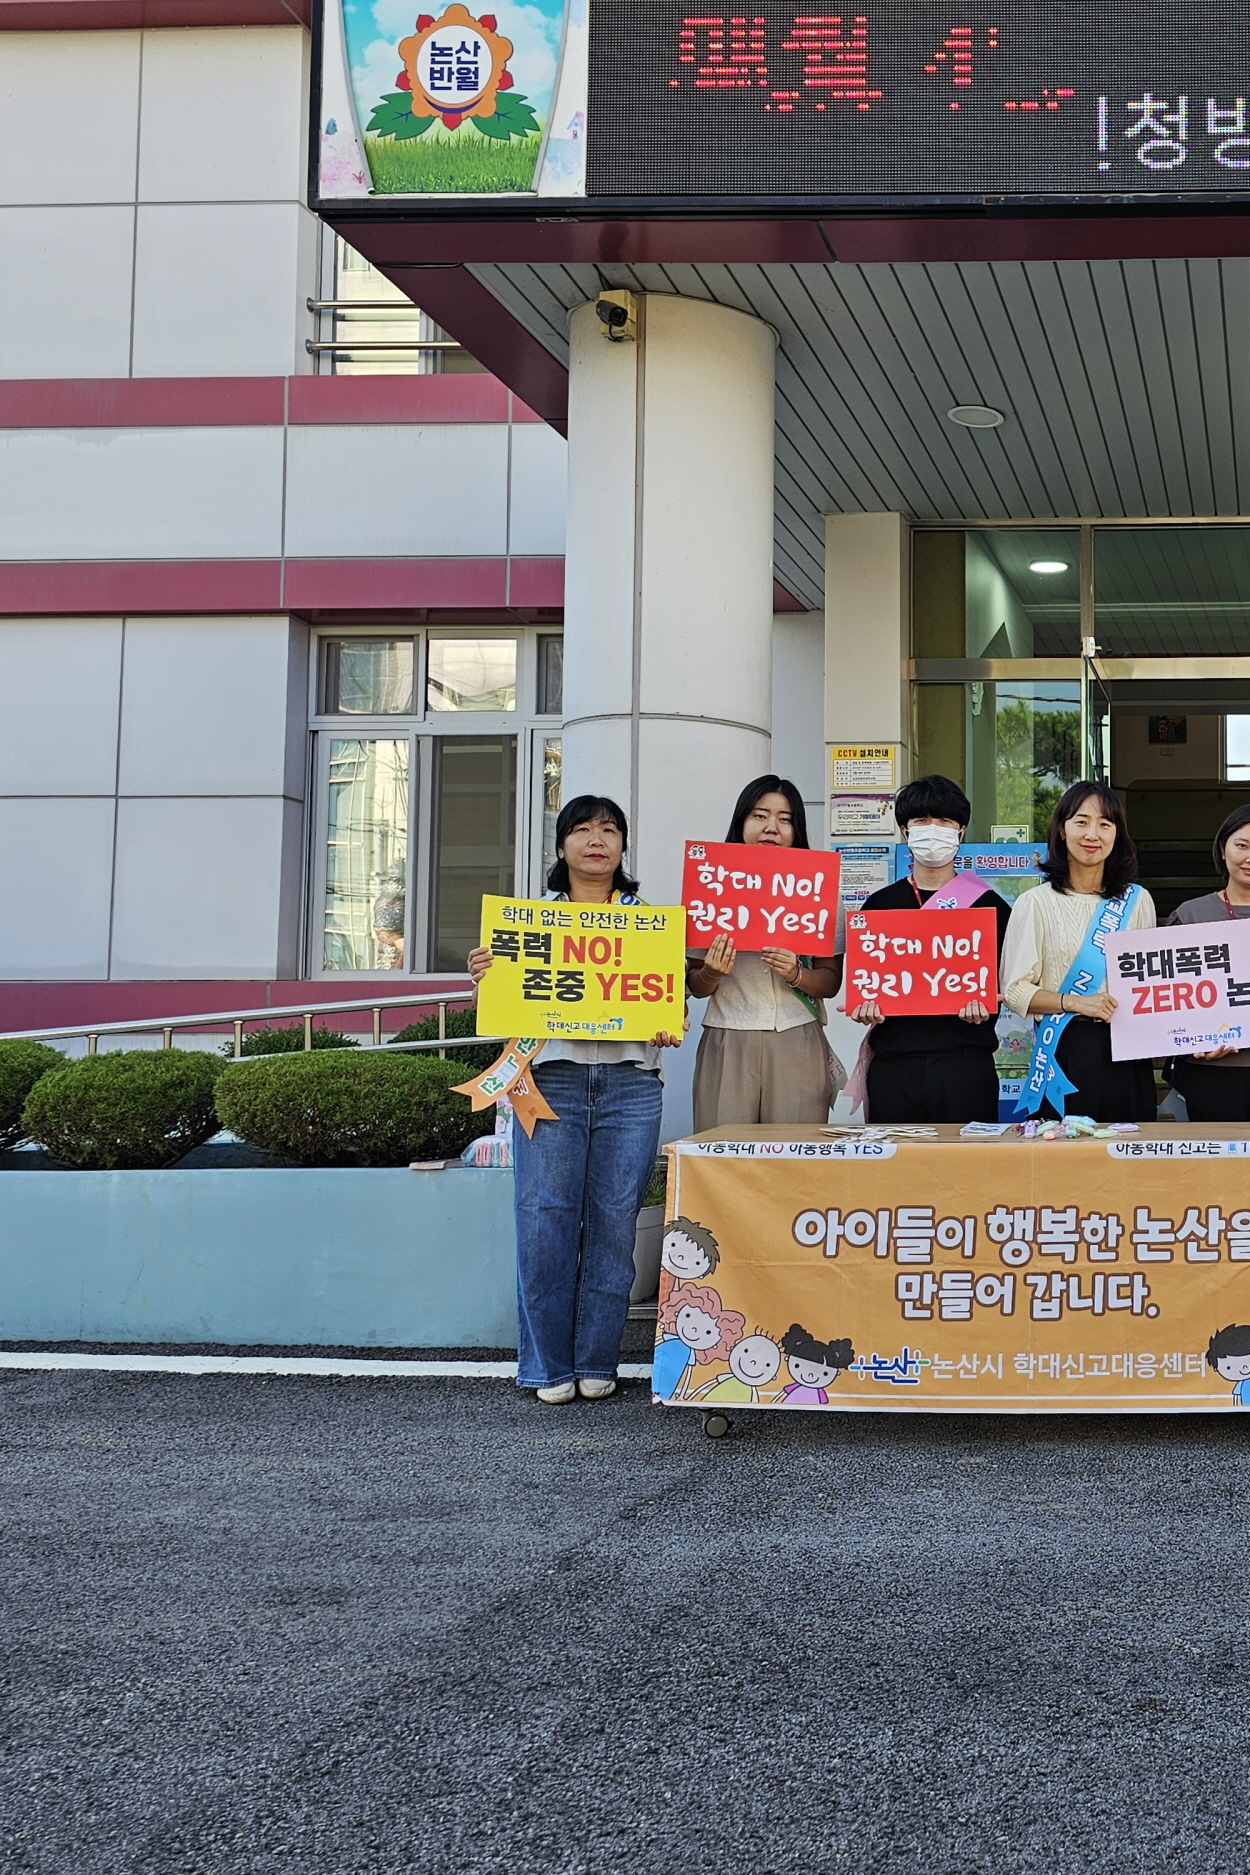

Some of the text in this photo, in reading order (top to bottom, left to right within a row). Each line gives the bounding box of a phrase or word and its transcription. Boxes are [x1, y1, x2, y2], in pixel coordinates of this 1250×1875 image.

[430, 41, 481, 65] 논산
[429, 66, 479, 91] 반월
[837, 748, 889, 758] CCTV 설치안내
[976, 855, 1030, 870] 환영합니다
[697, 861, 762, 896] 학대
[772, 872, 825, 902] No!
[502, 905, 667, 931] 학대 없는 안전한 논산
[687, 899, 829, 939] 권리 Yes!
[490, 928, 623, 967] 폭력 NO!
[859, 930, 981, 963] 학대 No!
[1117, 943, 1231, 982] 학대폭력
[522, 968, 675, 1003] 존중 YES!
[852, 966, 989, 1000] 권리 Yes!
[1131, 980, 1218, 1015] ZERO
[760, 1142, 784, 1154] NO
[853, 1143, 884, 1155] YES
[793, 1206, 976, 1264] 아이들이
[986, 1205, 1124, 1266] 행복한
[897, 1271, 1161, 1321] 만들어 갑니다.
[931, 1352, 1003, 1380] 논산시
[1013, 1352, 1207, 1380] 학대신고대응센터
